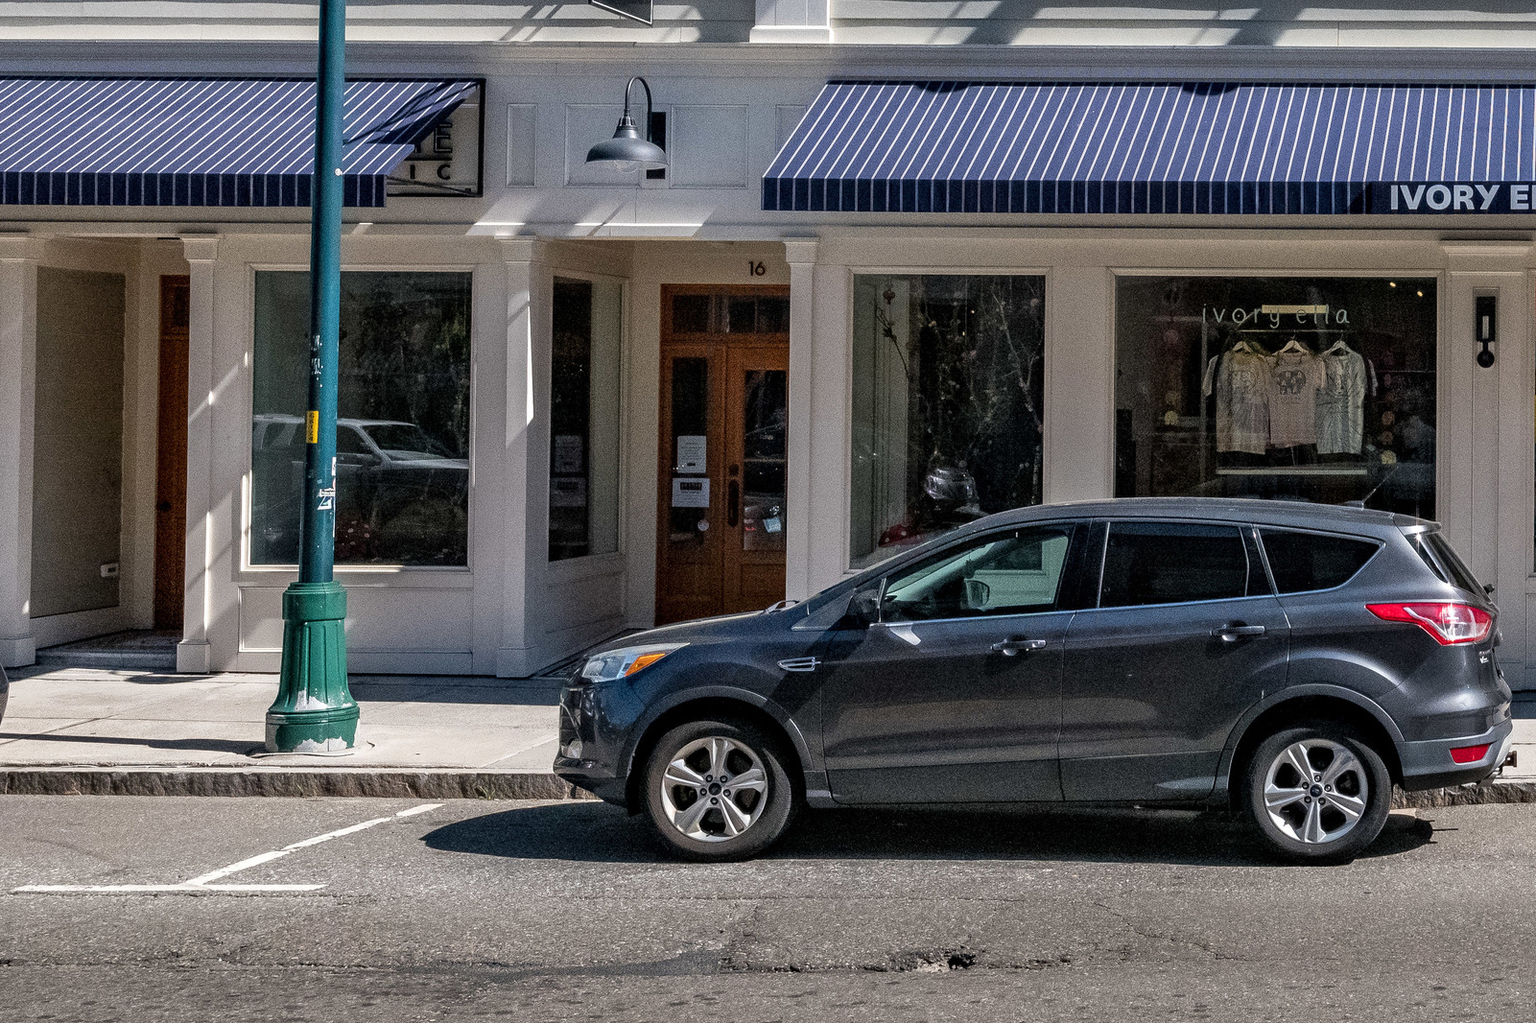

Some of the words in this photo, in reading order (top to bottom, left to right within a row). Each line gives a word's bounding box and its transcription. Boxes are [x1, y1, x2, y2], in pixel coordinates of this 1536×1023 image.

[1391, 184, 1500, 211] IVORY
[748, 260, 766, 277] 16
[1202, 303, 1281, 329] ivory
[1295, 303, 1350, 325] ella
